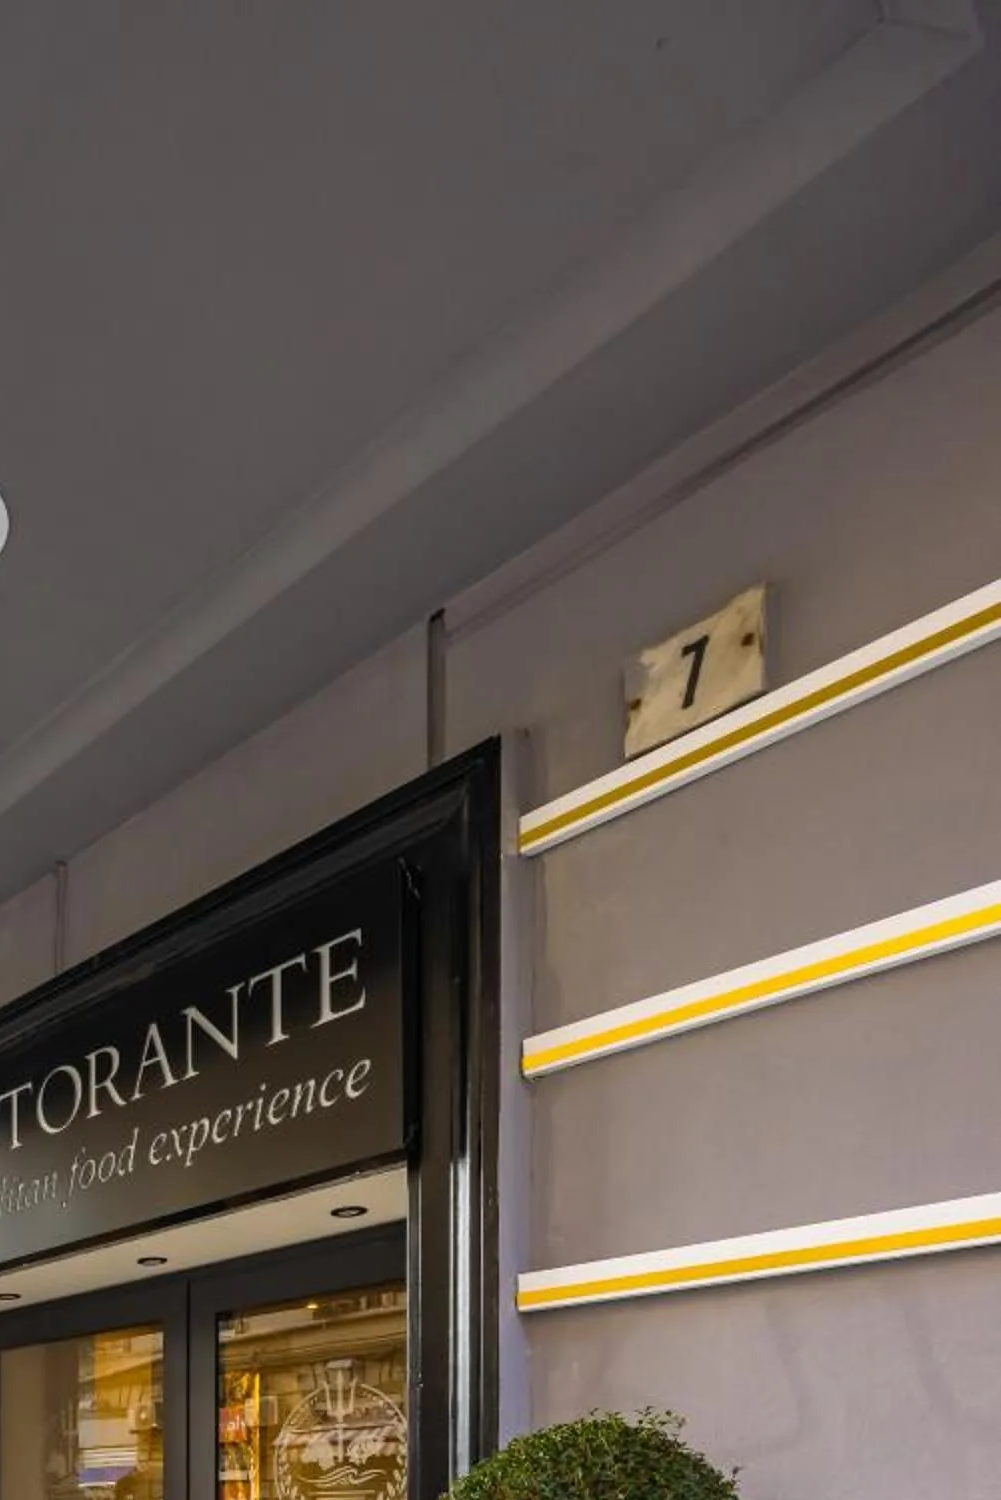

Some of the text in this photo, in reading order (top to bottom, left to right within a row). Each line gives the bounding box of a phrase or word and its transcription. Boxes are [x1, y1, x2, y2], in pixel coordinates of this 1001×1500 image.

[681, 633, 710, 710] 7
[61, 1127, 140, 1208] food
[148, 1058, 372, 1167] experience
